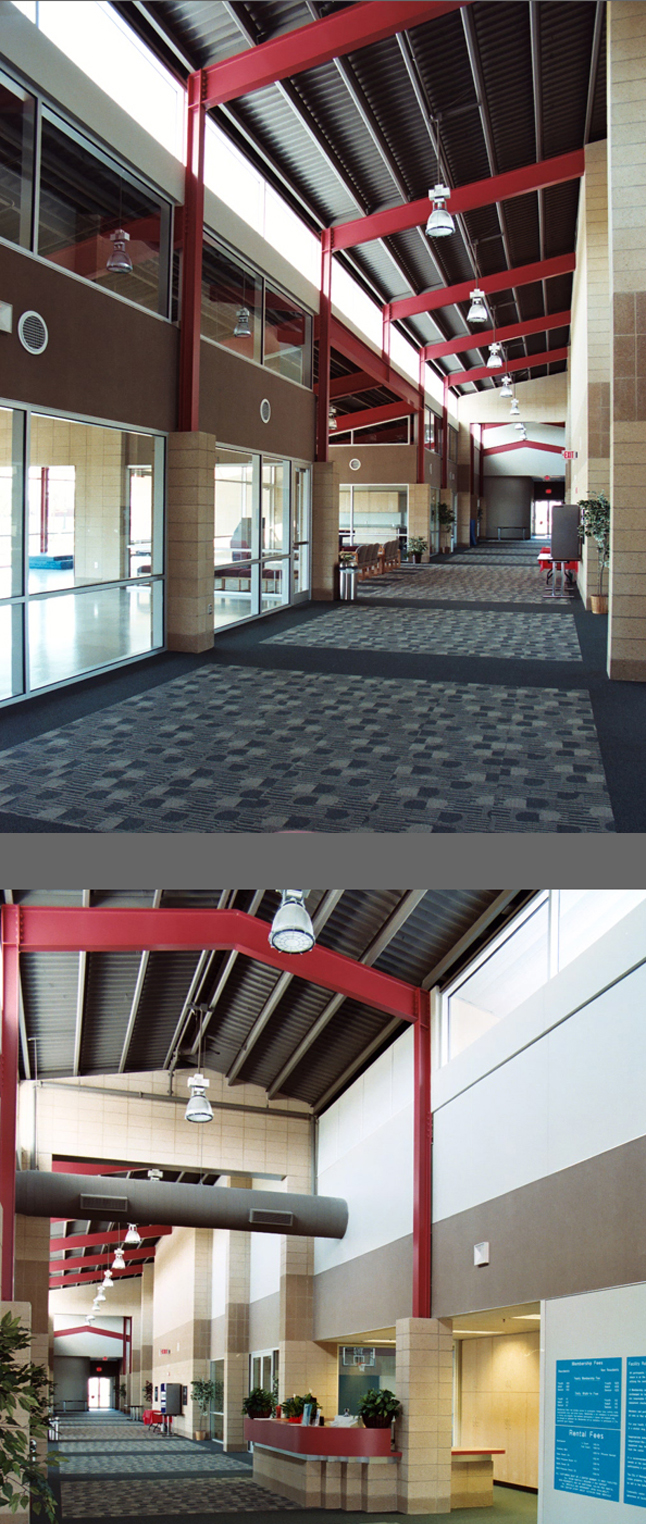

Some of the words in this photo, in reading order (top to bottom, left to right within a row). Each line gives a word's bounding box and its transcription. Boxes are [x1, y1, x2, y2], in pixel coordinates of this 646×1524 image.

[563, 451, 574, 459] EXIT
[569, 1429, 587, 1437] Rental
[589, 1431, 604, 1439] Fees
